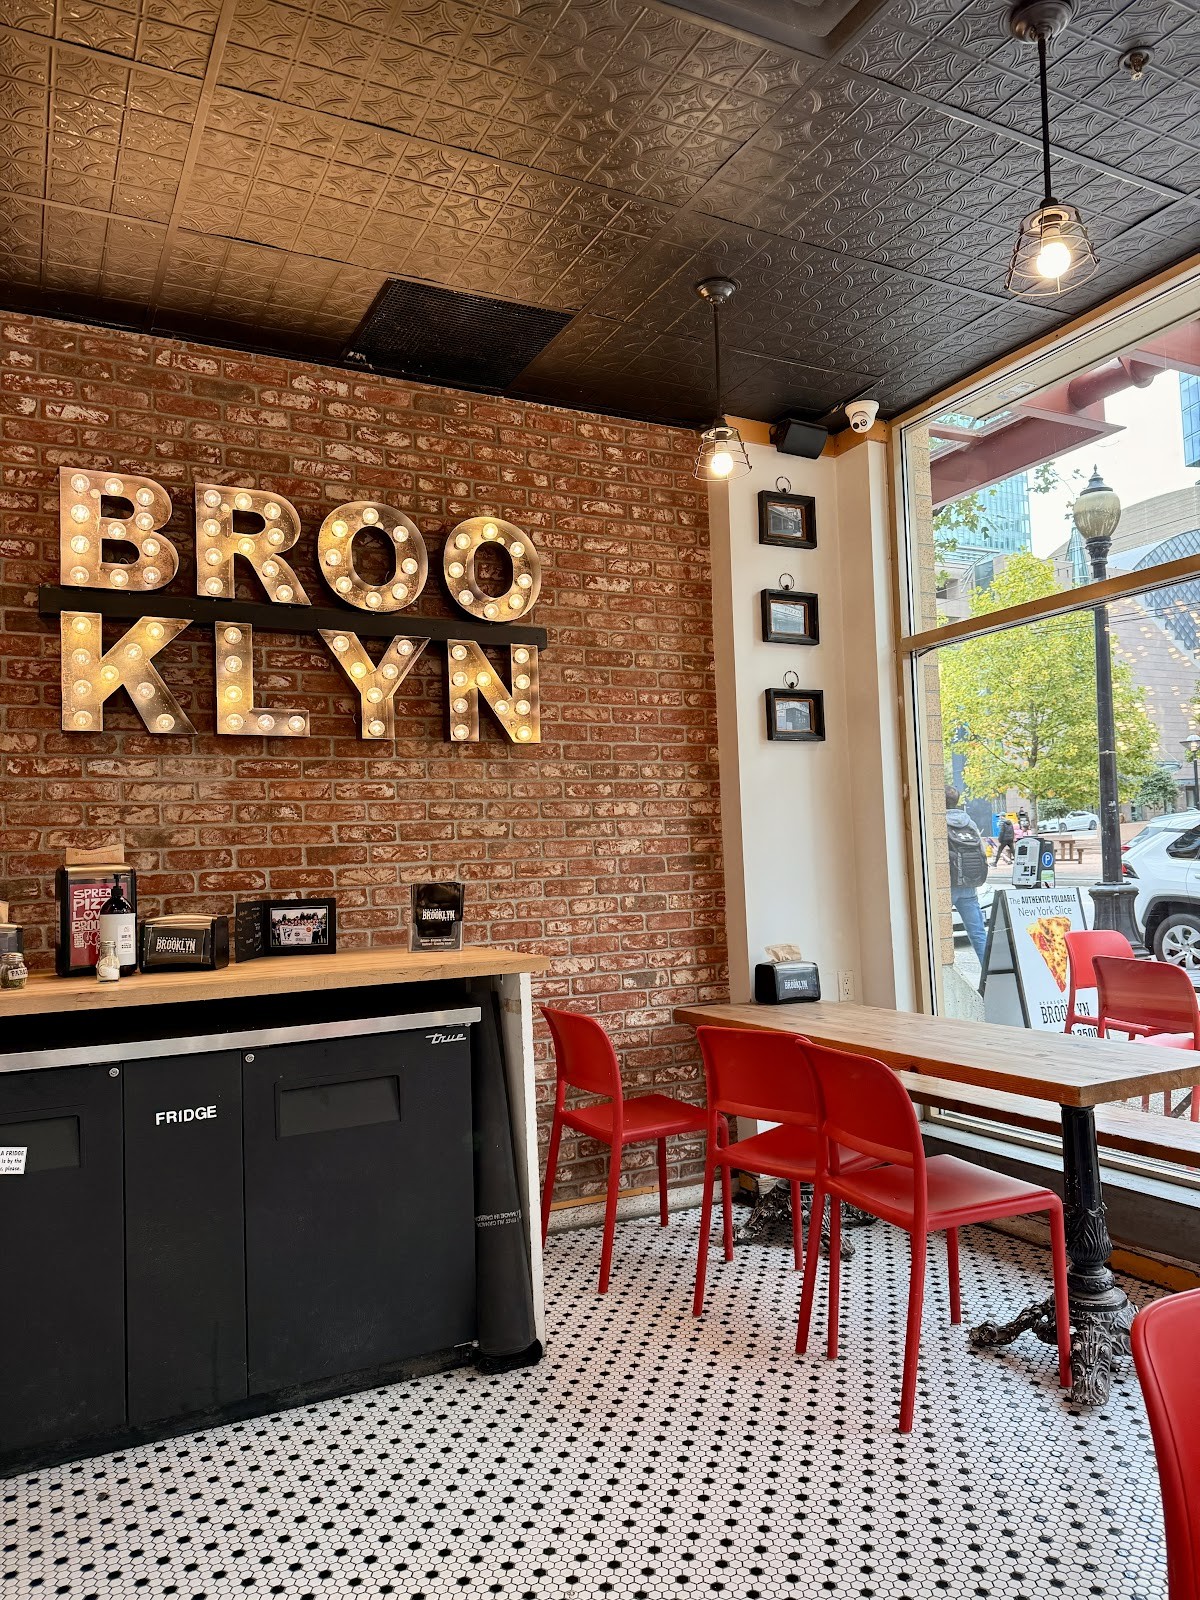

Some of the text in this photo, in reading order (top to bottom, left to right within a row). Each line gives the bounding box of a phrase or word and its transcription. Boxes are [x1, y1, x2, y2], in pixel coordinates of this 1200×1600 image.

[59, 466, 542, 622] BROO
[60, 610, 542, 744] KLYN
[73, 888, 112, 899] SPREA
[1009, 894, 1076, 905] The AUTHENTIC FOLDABLE
[73, 898, 111, 912] PIZZ
[1018, 905, 1073, 917] New York Slice
[72, 910, 101, 921] LOV
[422, 910, 456, 920] BROOKLYN
[71, 920, 101, 933] BROO
[156, 938, 196, 952] BROOKLYN
[1040, 1002, 1091, 1024] BROOYN
[155, 1105, 217, 1126] FRIDGE
